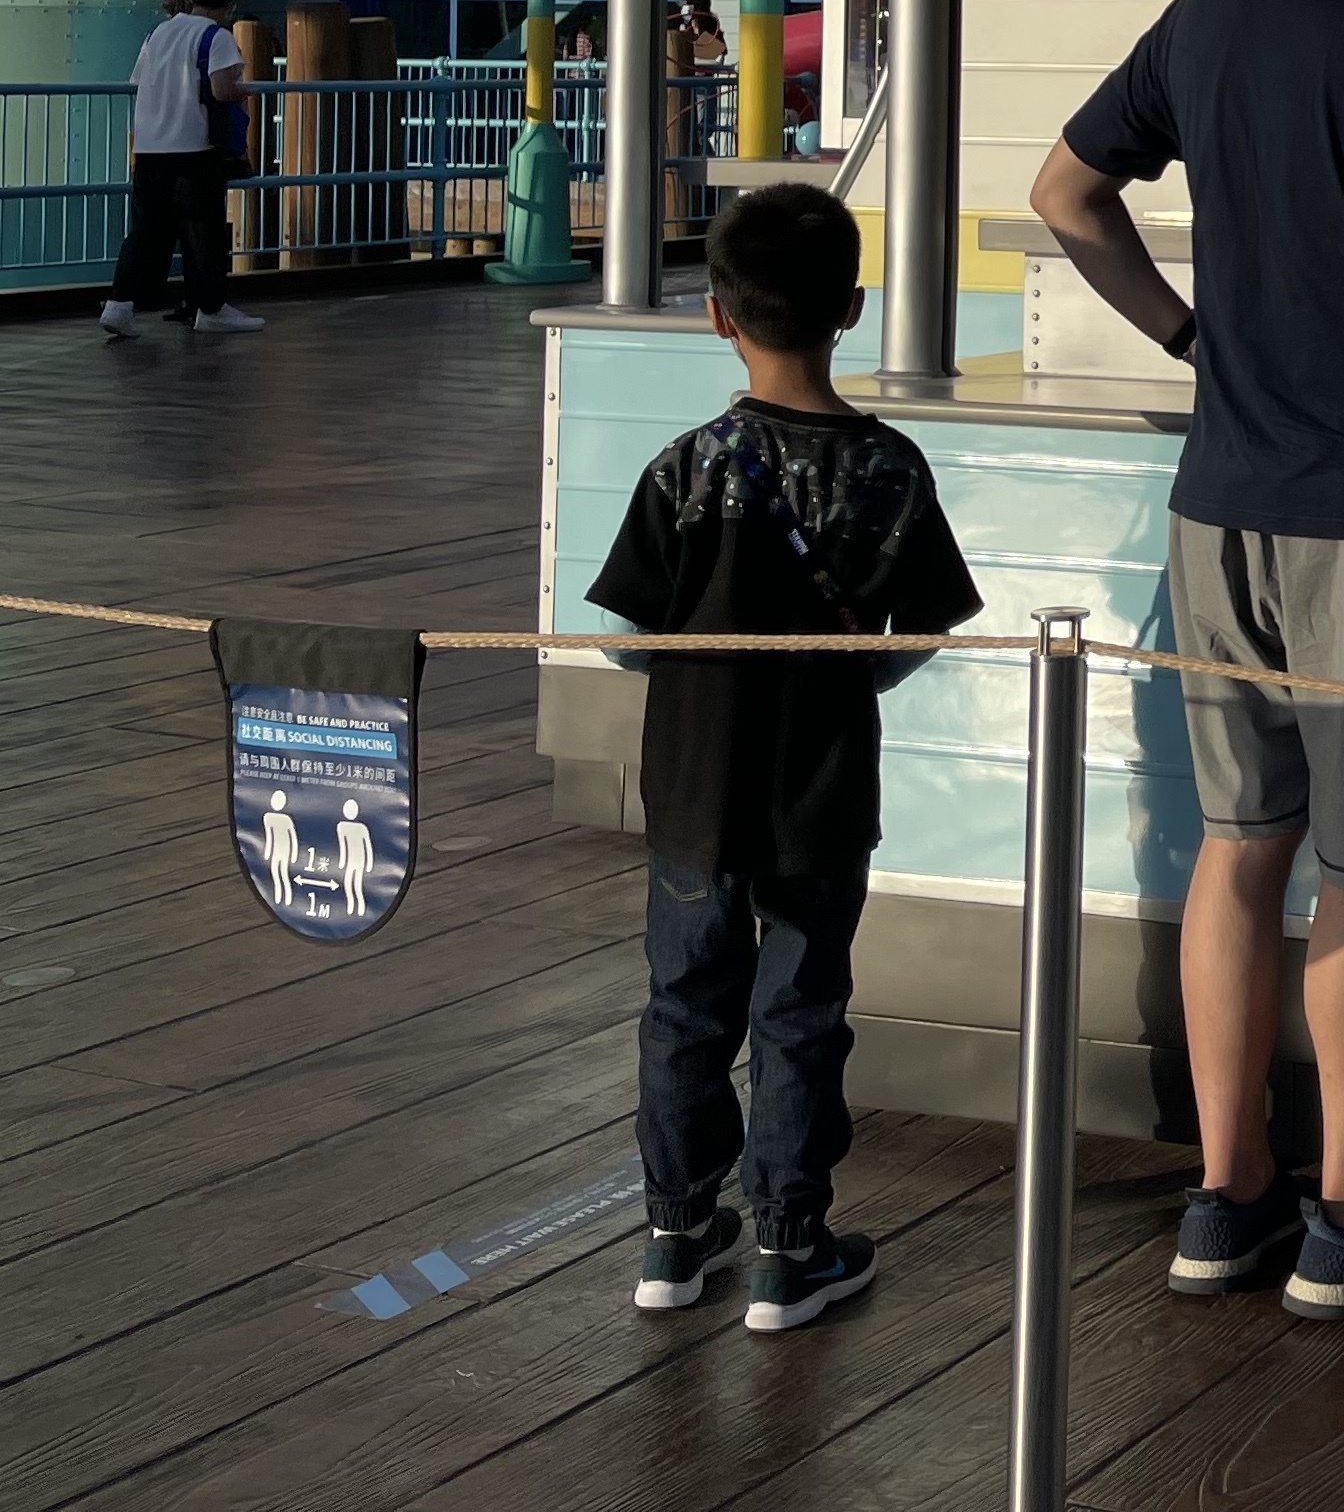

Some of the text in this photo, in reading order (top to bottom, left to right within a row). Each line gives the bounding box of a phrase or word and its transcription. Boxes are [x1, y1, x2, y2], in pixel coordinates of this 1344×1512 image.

[296, 715, 307, 724] BE
[308, 716, 329, 727] SAFE
[330, 719, 347, 728] AND
[349, 720, 389, 732] PRACTICE
[241, 724, 393, 752] 社交距离 SOCIAL DISTANCING
[304, 847, 330, 872] 1米
[305, 892, 330, 918] 1M
